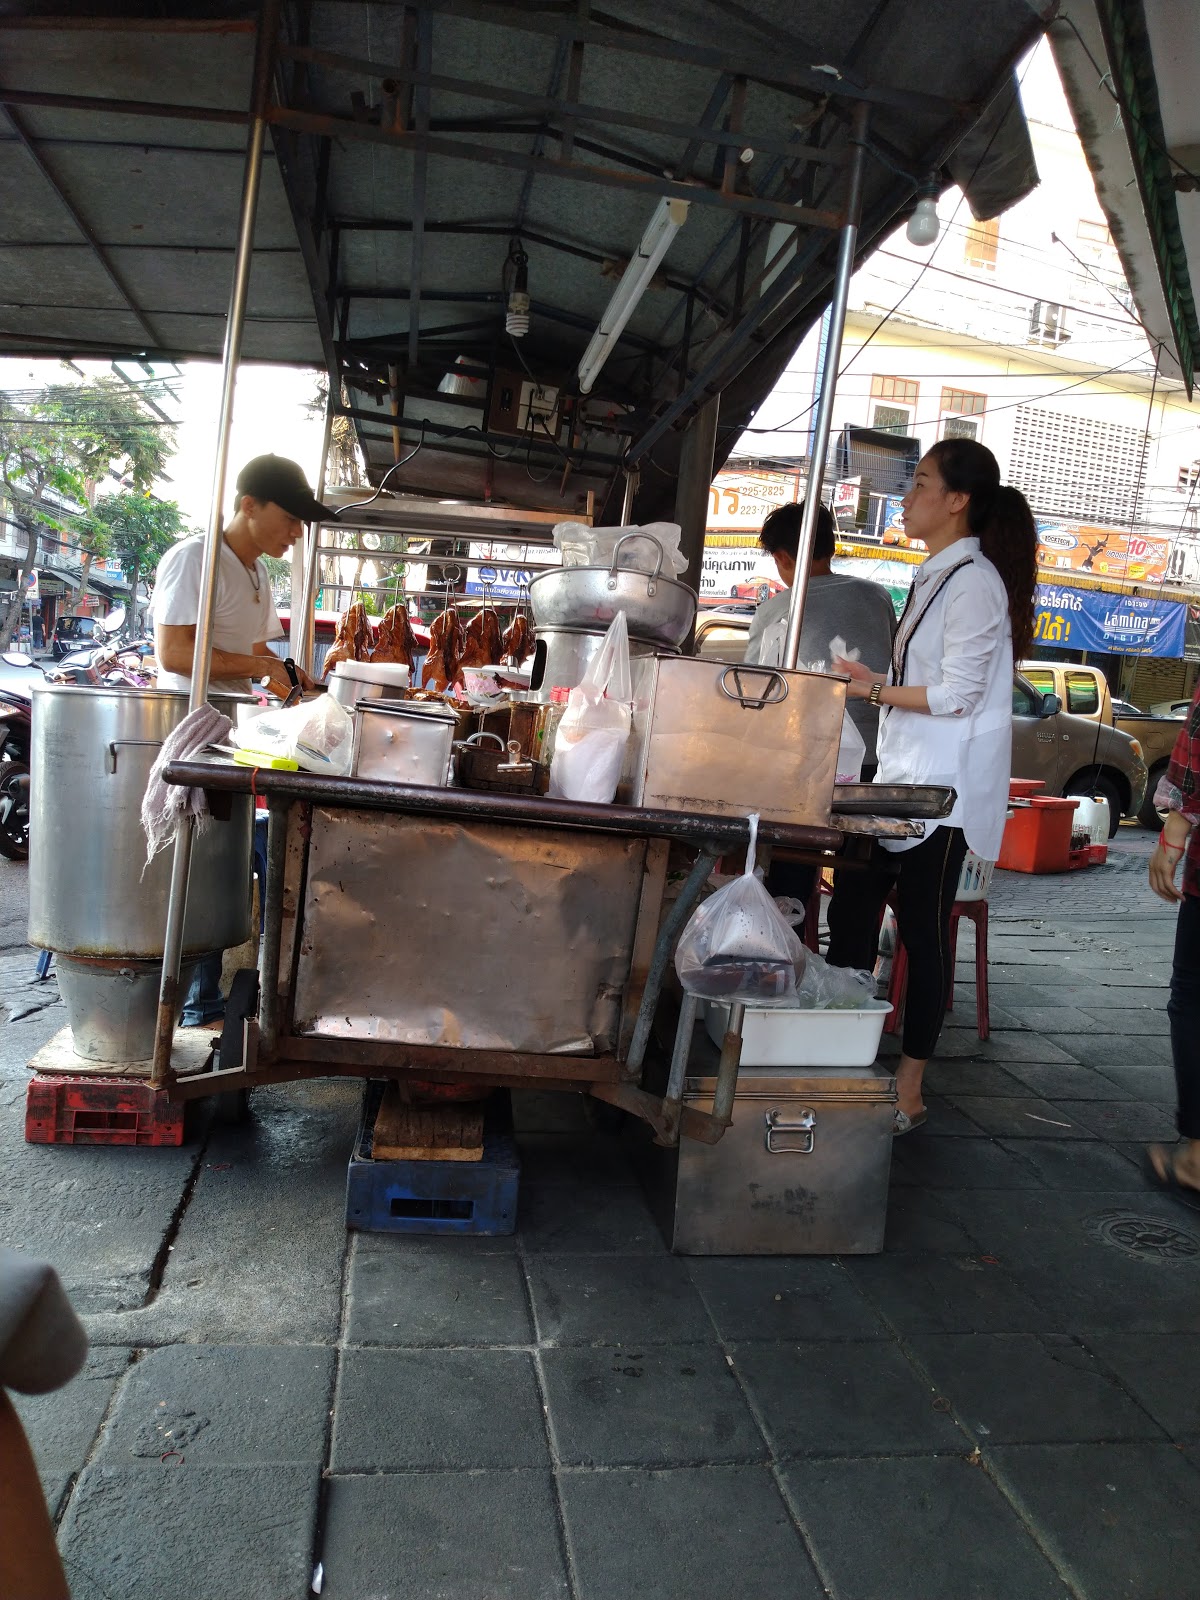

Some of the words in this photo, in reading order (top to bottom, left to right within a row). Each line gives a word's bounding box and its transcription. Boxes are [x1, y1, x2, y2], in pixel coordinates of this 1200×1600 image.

[740, 504, 780, 515] 223-717
[701, 557, 756, 574] น์คุณภาพ
[1104, 611, 1148, 629] Lamina
